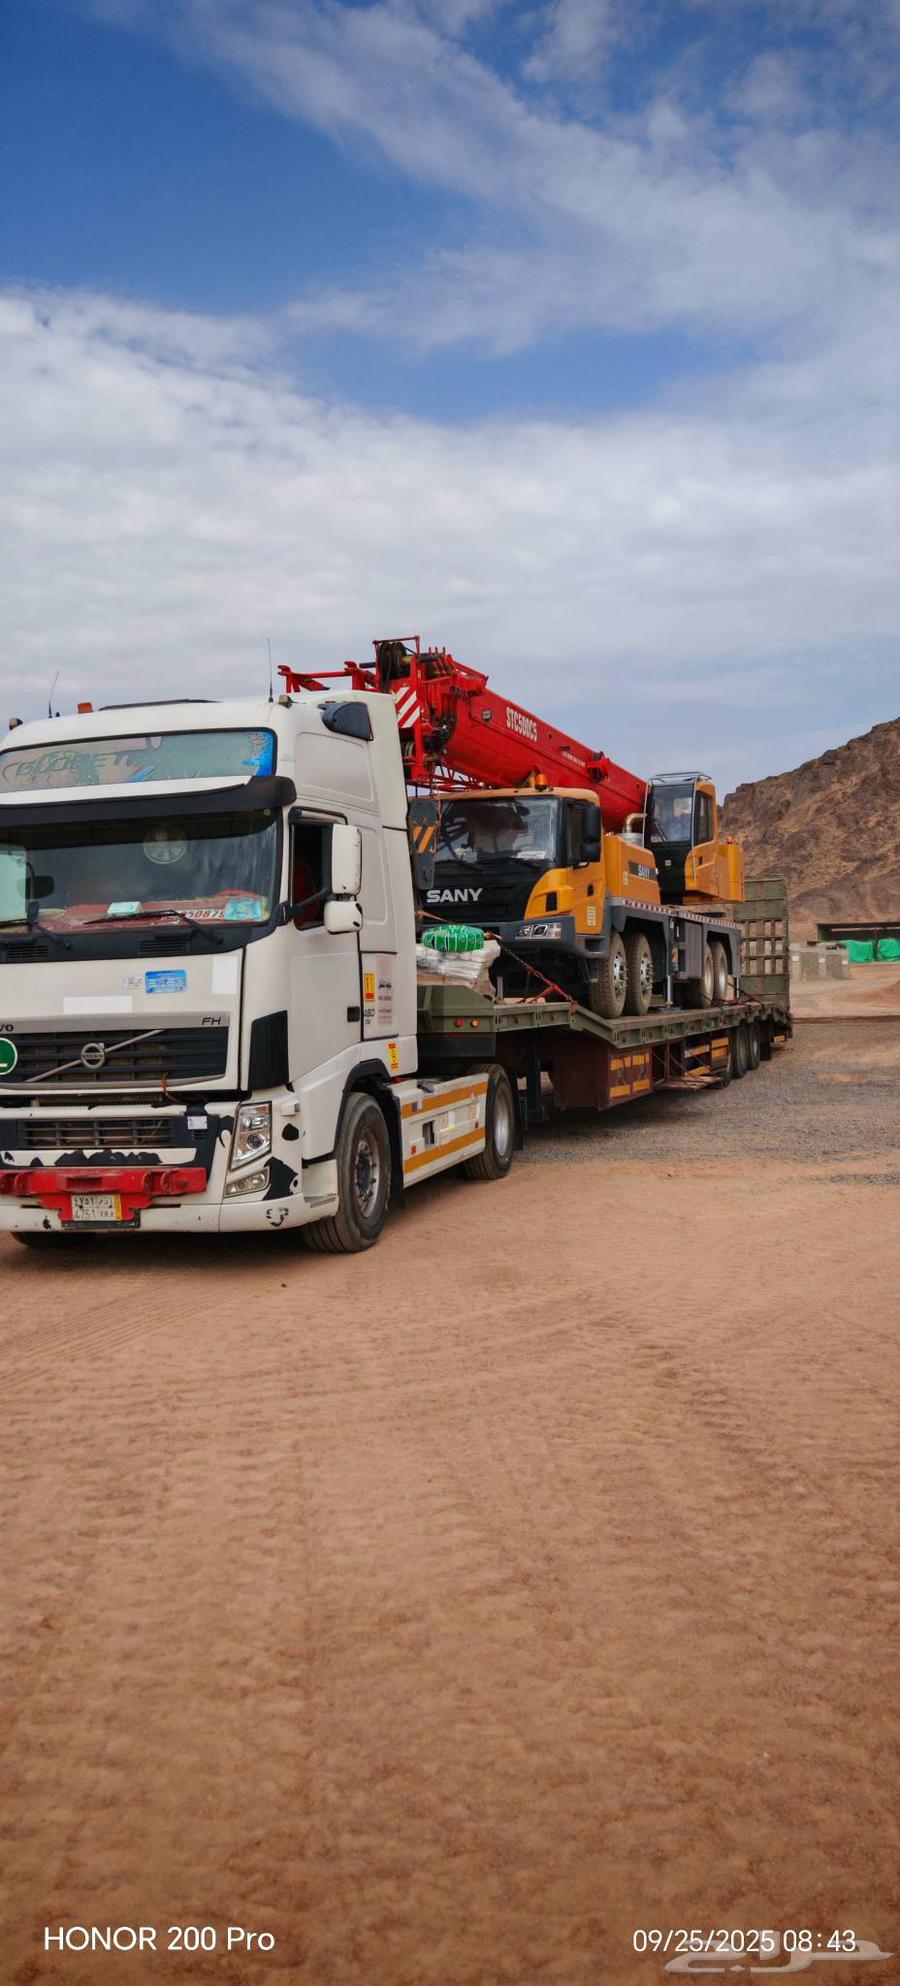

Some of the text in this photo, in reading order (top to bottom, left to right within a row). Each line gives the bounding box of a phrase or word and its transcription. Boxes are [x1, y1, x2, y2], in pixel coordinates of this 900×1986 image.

[506, 706, 538, 742] STC500C5
[426, 888, 483, 903] SANY
[202, 1016, 221, 1026] FH
